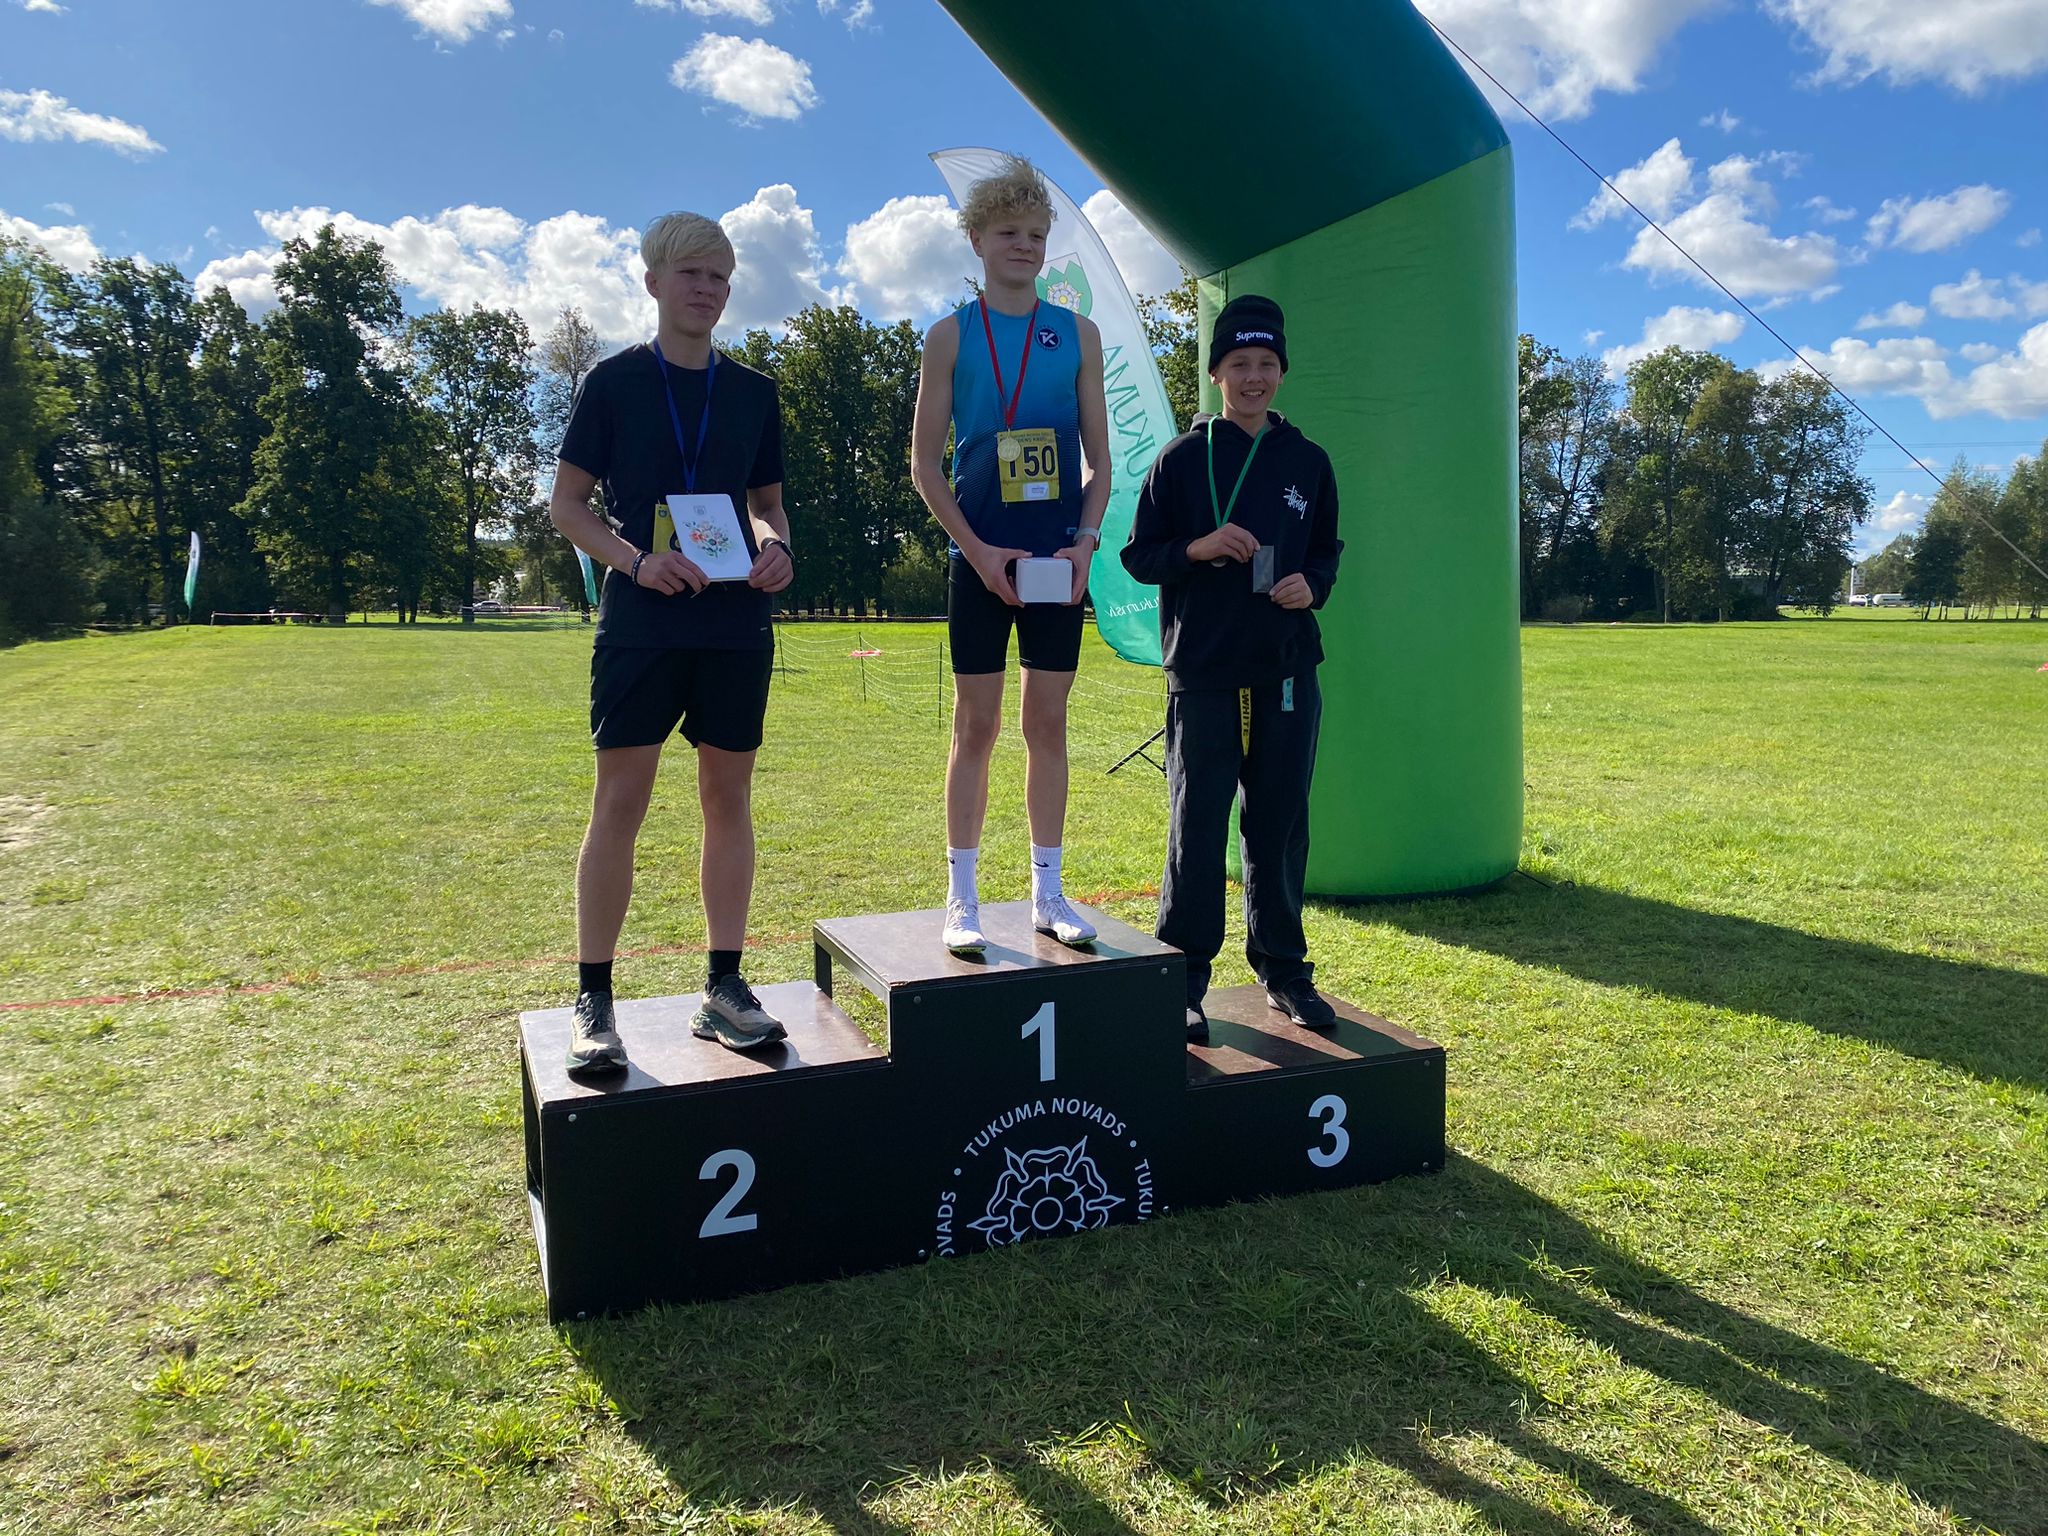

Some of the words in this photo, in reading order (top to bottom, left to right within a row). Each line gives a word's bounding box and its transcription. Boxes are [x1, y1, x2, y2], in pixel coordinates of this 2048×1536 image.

[1236, 331, 1274, 342] Supreme
[1021, 1001, 1056, 1082] 1
[963, 1099, 1046, 1157] TUKUMA
[1051, 1097, 1127, 1137] NOVADS
[1307, 1094, 1350, 1168] 3
[698, 1149, 758, 1239] 2
[1134, 1158, 1153, 1221] TUKU
